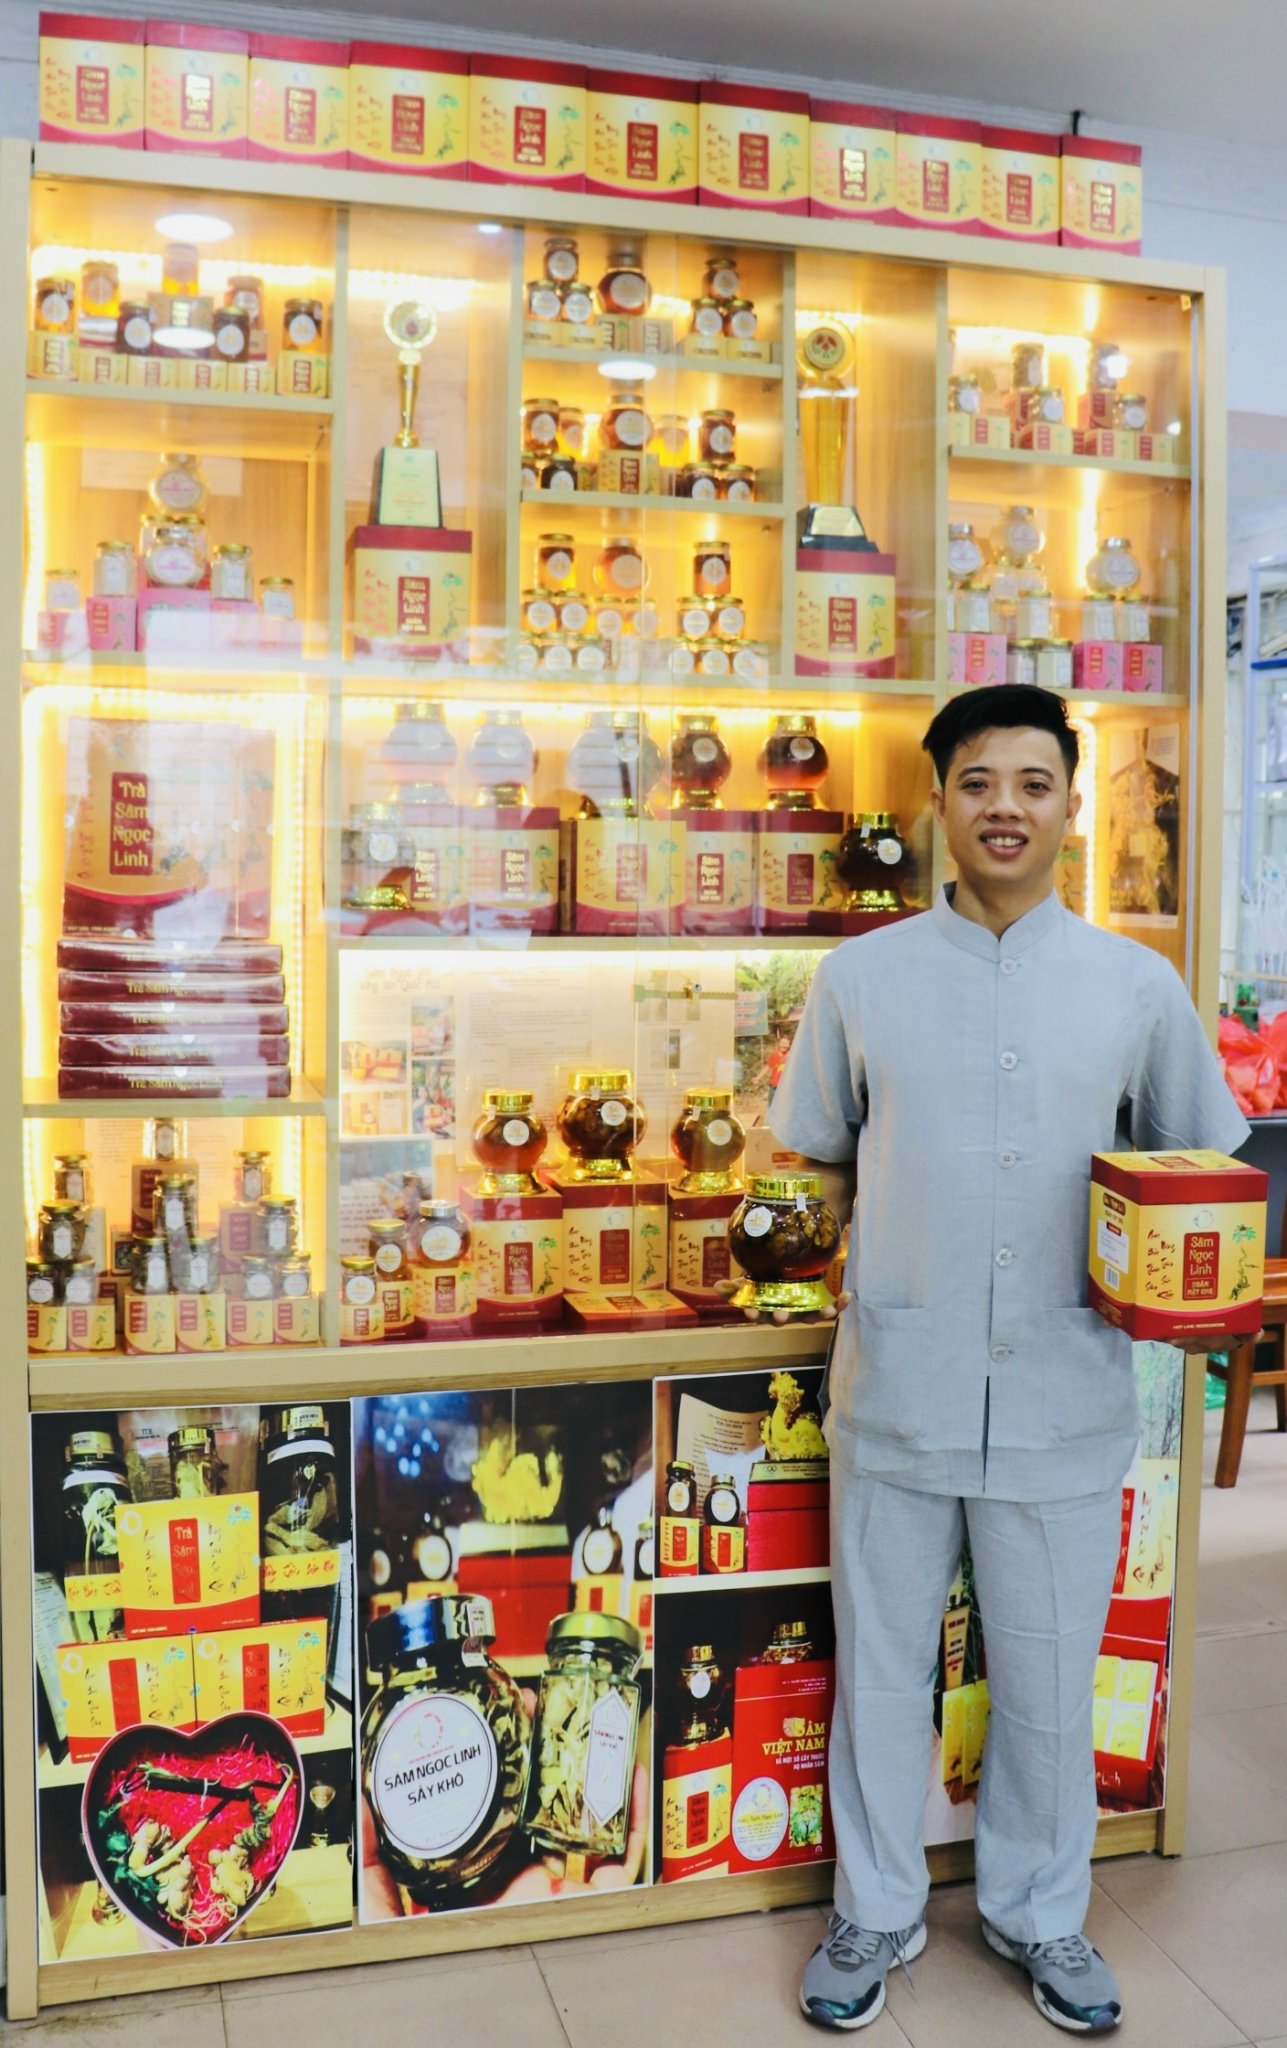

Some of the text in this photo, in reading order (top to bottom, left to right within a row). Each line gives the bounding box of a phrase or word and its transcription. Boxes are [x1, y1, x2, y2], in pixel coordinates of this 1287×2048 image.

[119, 781, 146, 798] Trà
[114, 850, 149, 867] Linh
[1190, 1236, 1214, 1248] Sâm
[1189, 1249, 1215, 1264] Ngọc
[1190, 1263, 1212, 1276] Linh
[454, 1743, 481, 1765] LINH
[762, 1737, 825, 1756] VIỆT NAM
